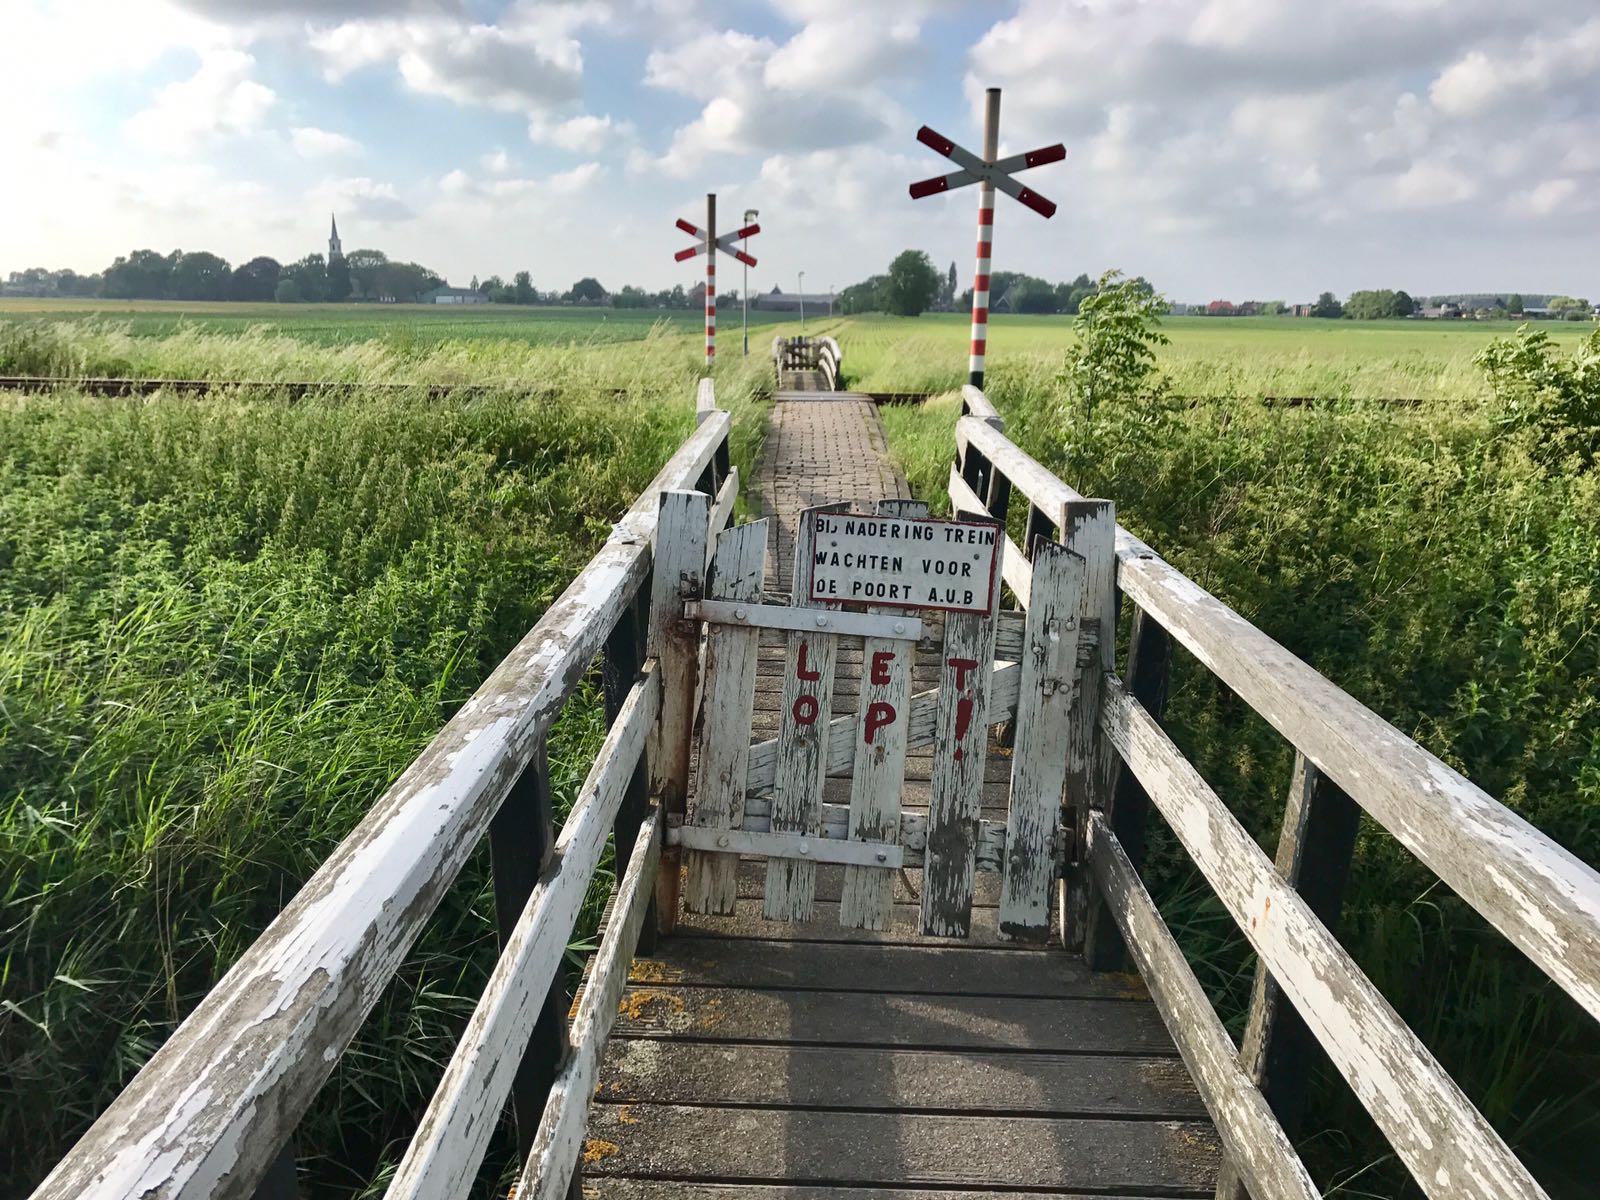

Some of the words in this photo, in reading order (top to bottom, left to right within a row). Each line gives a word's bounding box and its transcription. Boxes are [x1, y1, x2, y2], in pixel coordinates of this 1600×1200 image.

[816, 518, 838, 534] BIJ
[845, 521, 934, 541] NADERING
[944, 528, 995, 546] TREIN
[816, 551, 902, 572] WACHTEN
[922, 559, 971, 577] VOOR
[816, 578, 837, 594] DE
[853, 581, 912, 600] POORT
[928, 587, 973, 605] A.U.B
